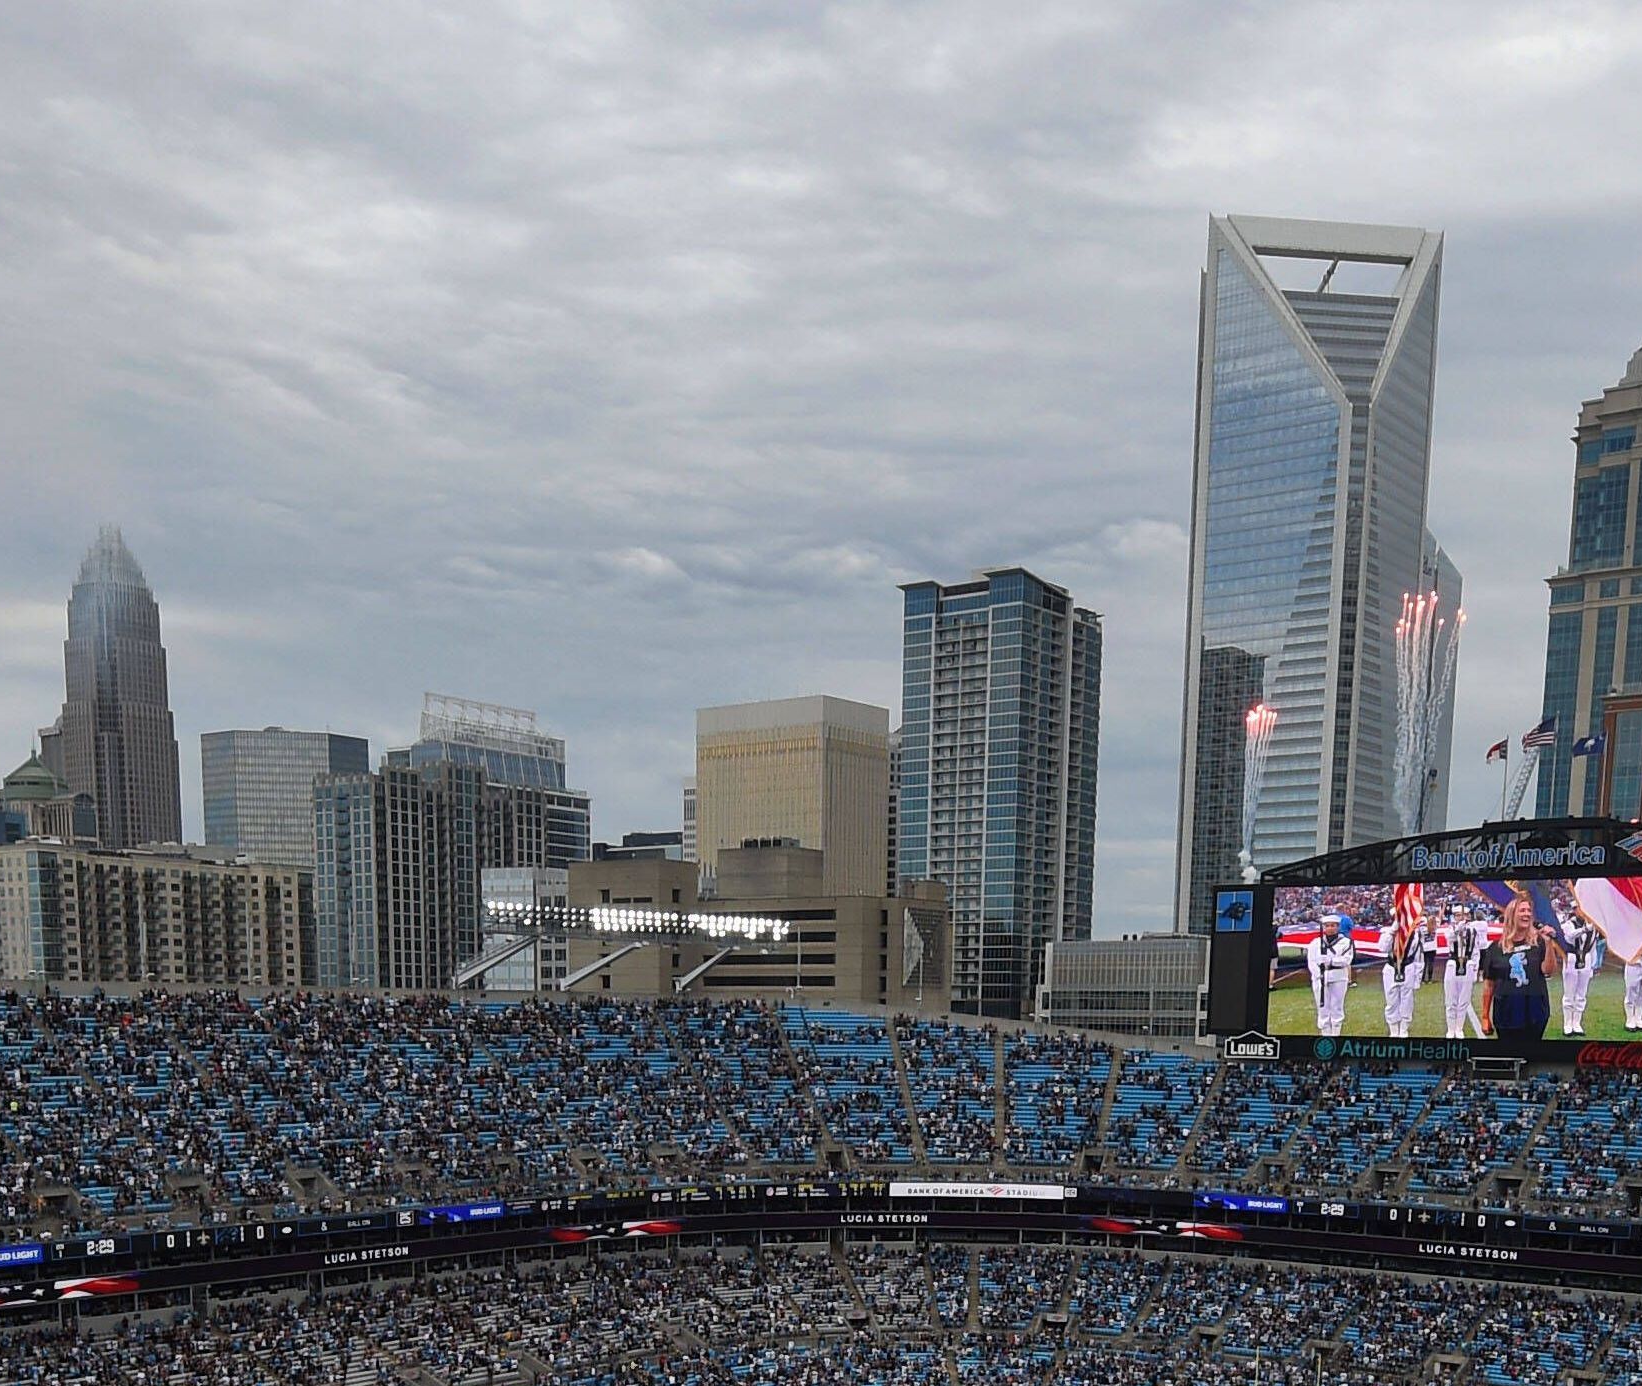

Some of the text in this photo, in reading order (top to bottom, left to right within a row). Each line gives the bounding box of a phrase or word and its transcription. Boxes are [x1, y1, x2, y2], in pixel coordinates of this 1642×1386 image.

[1412, 841, 1605, 870] Bank of America
[1230, 1040, 1274, 1056] LOWE'S
[1339, 1039, 1470, 1060] Atrium Health
[1320, 1203, 1344, 1216] 2:29
[840, 1214, 928, 1223] LUCIA STETSON
[86, 1239, 115, 1255] 2:29
[1418, 1243, 1518, 1261] LUCIA STETSON
[12, 1250, 39, 1261] LIGHT
[324, 1246, 409, 1265] LUCIA STETSON
